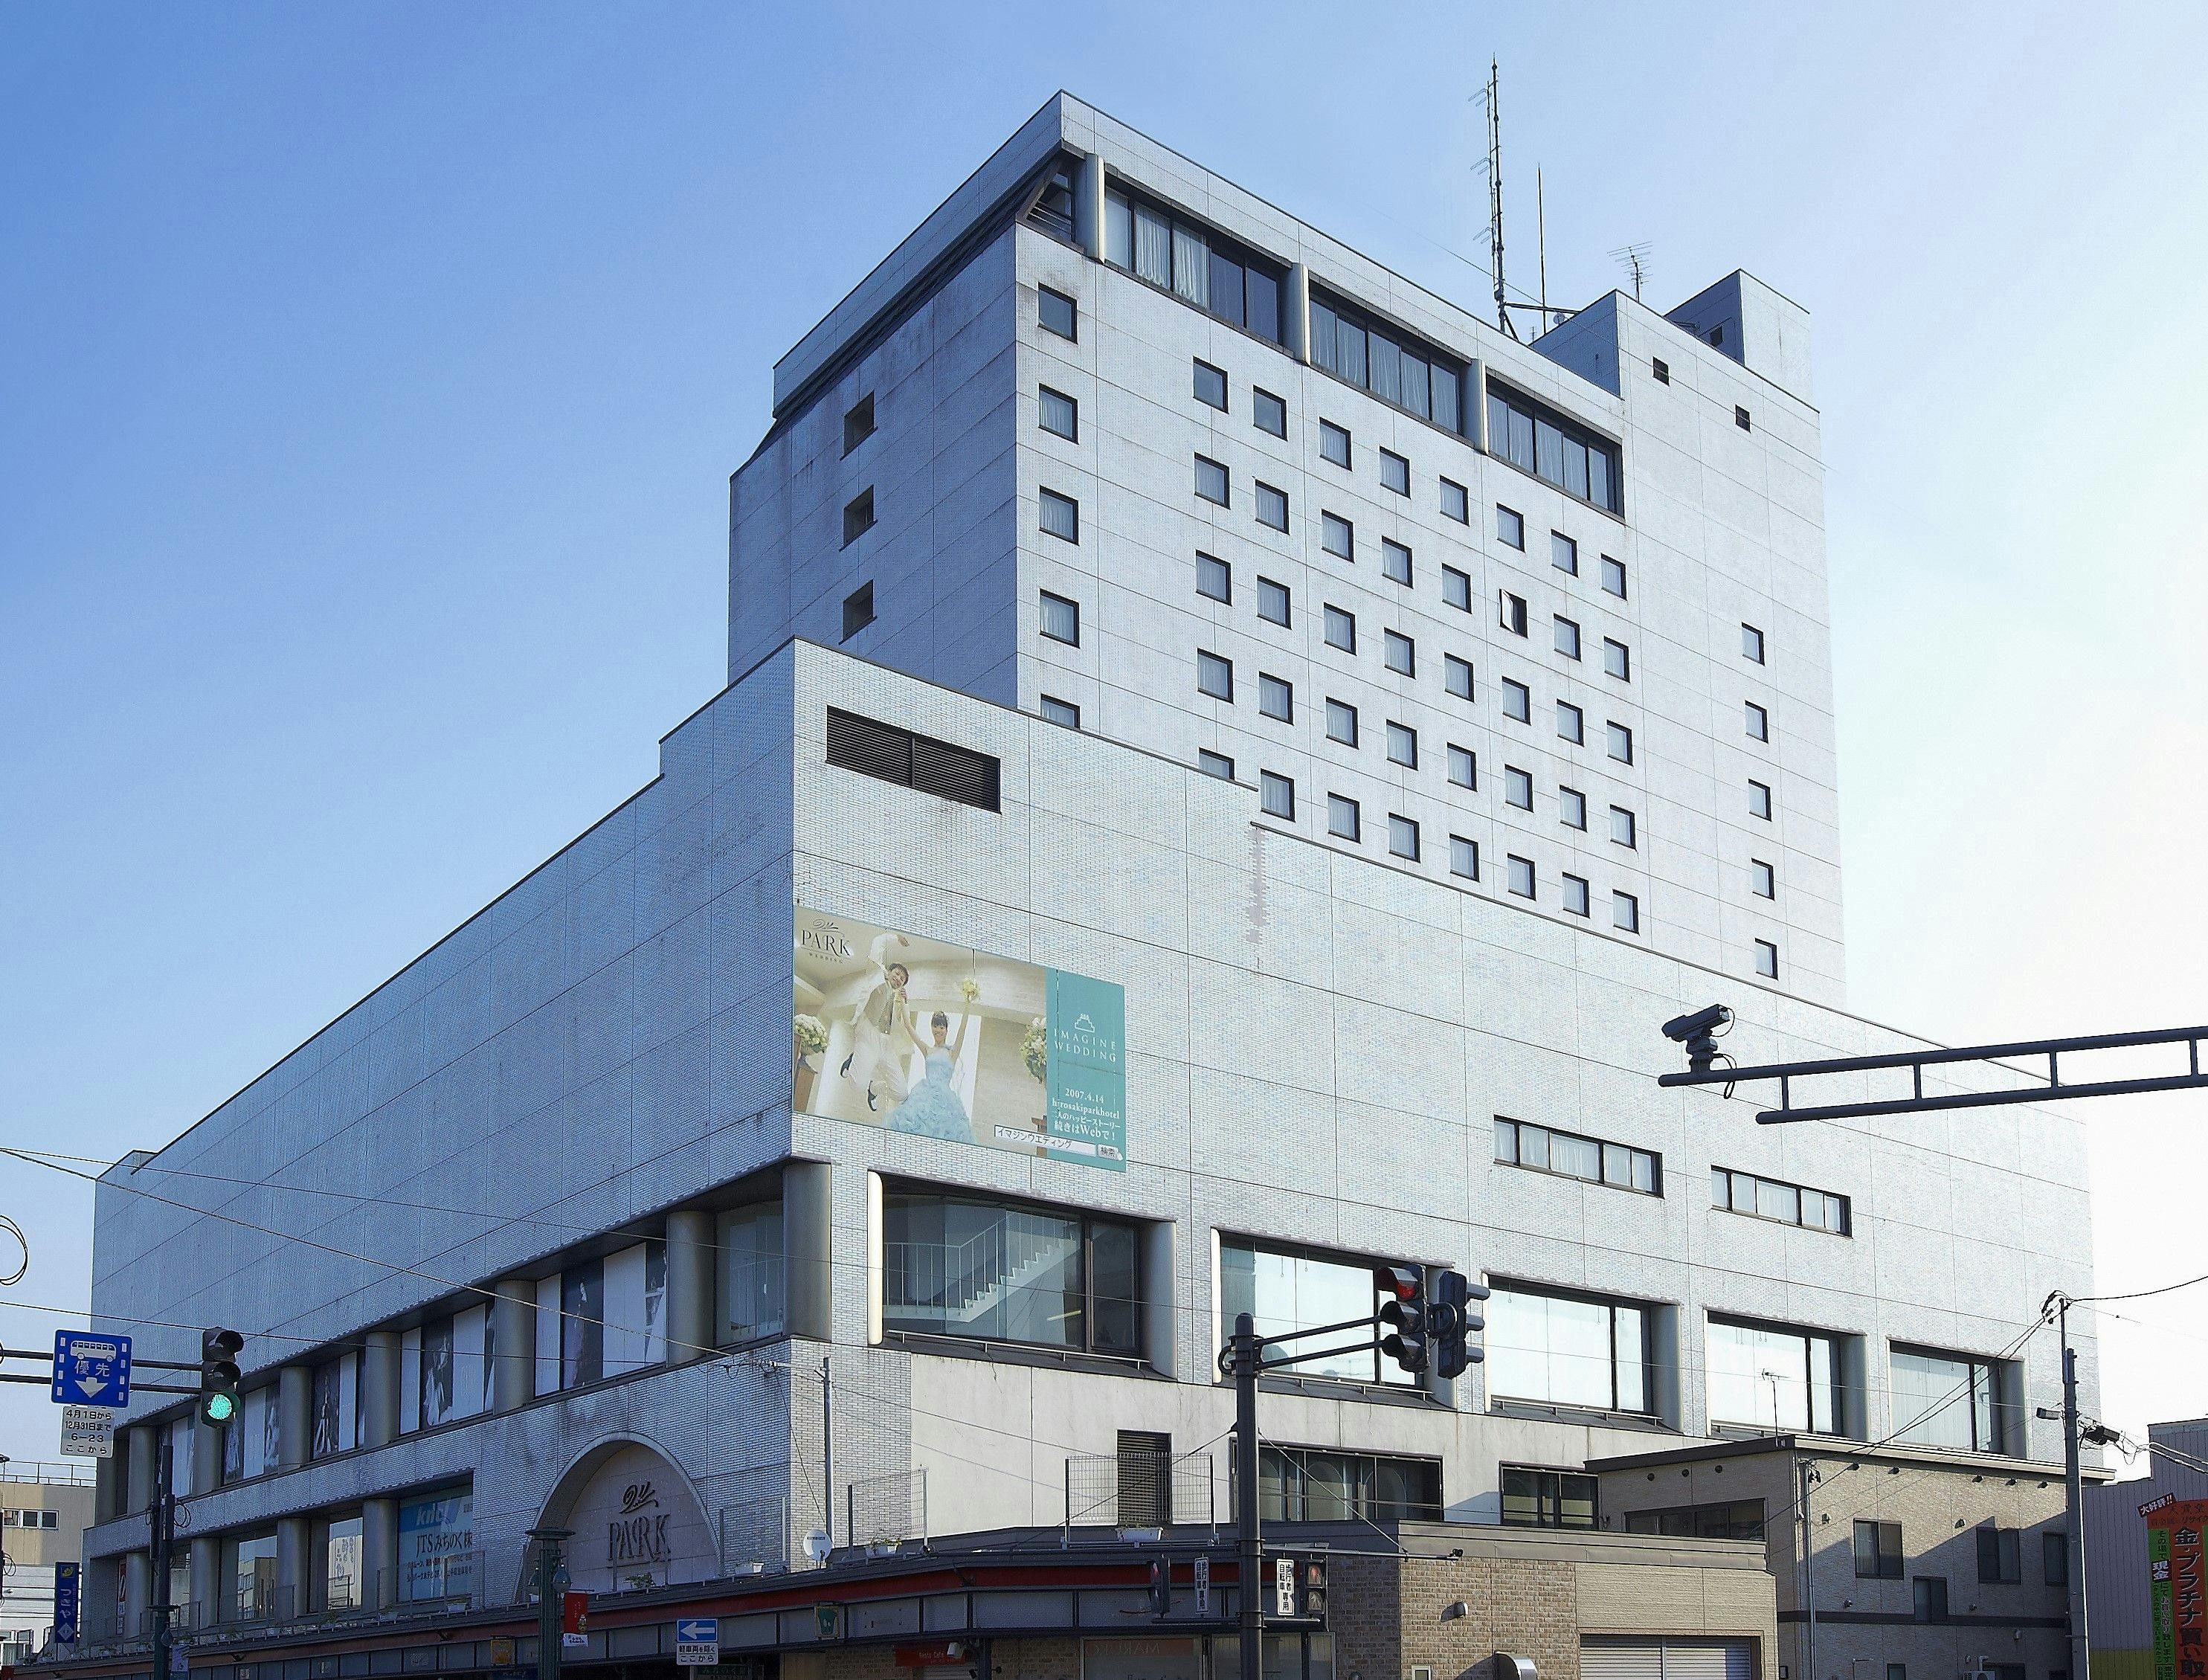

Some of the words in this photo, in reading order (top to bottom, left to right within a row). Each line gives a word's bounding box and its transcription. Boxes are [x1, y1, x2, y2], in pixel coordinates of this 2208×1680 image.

[801, 930, 850, 957] PARK
[1054, 1028, 1116, 1050] IMAGINE
[1054, 1040, 1116, 1063] WEDDING
[1065, 1088, 1104, 1104] 2007.4.14
[1052, 1098, 1120, 1119] hirosakiparkhotel
[74, 1360, 110, 1377] 優先
[65, 1409, 112, 1420] 4月1日から
[65, 1420, 112, 1432] 12月31日まで
[65, 1445, 107, 1455] ここから
[608, 1514, 671, 1560] PARK
[679, 1645, 715, 1653] 軽車両を除く
[680, 1655, 714, 1663] ここから
